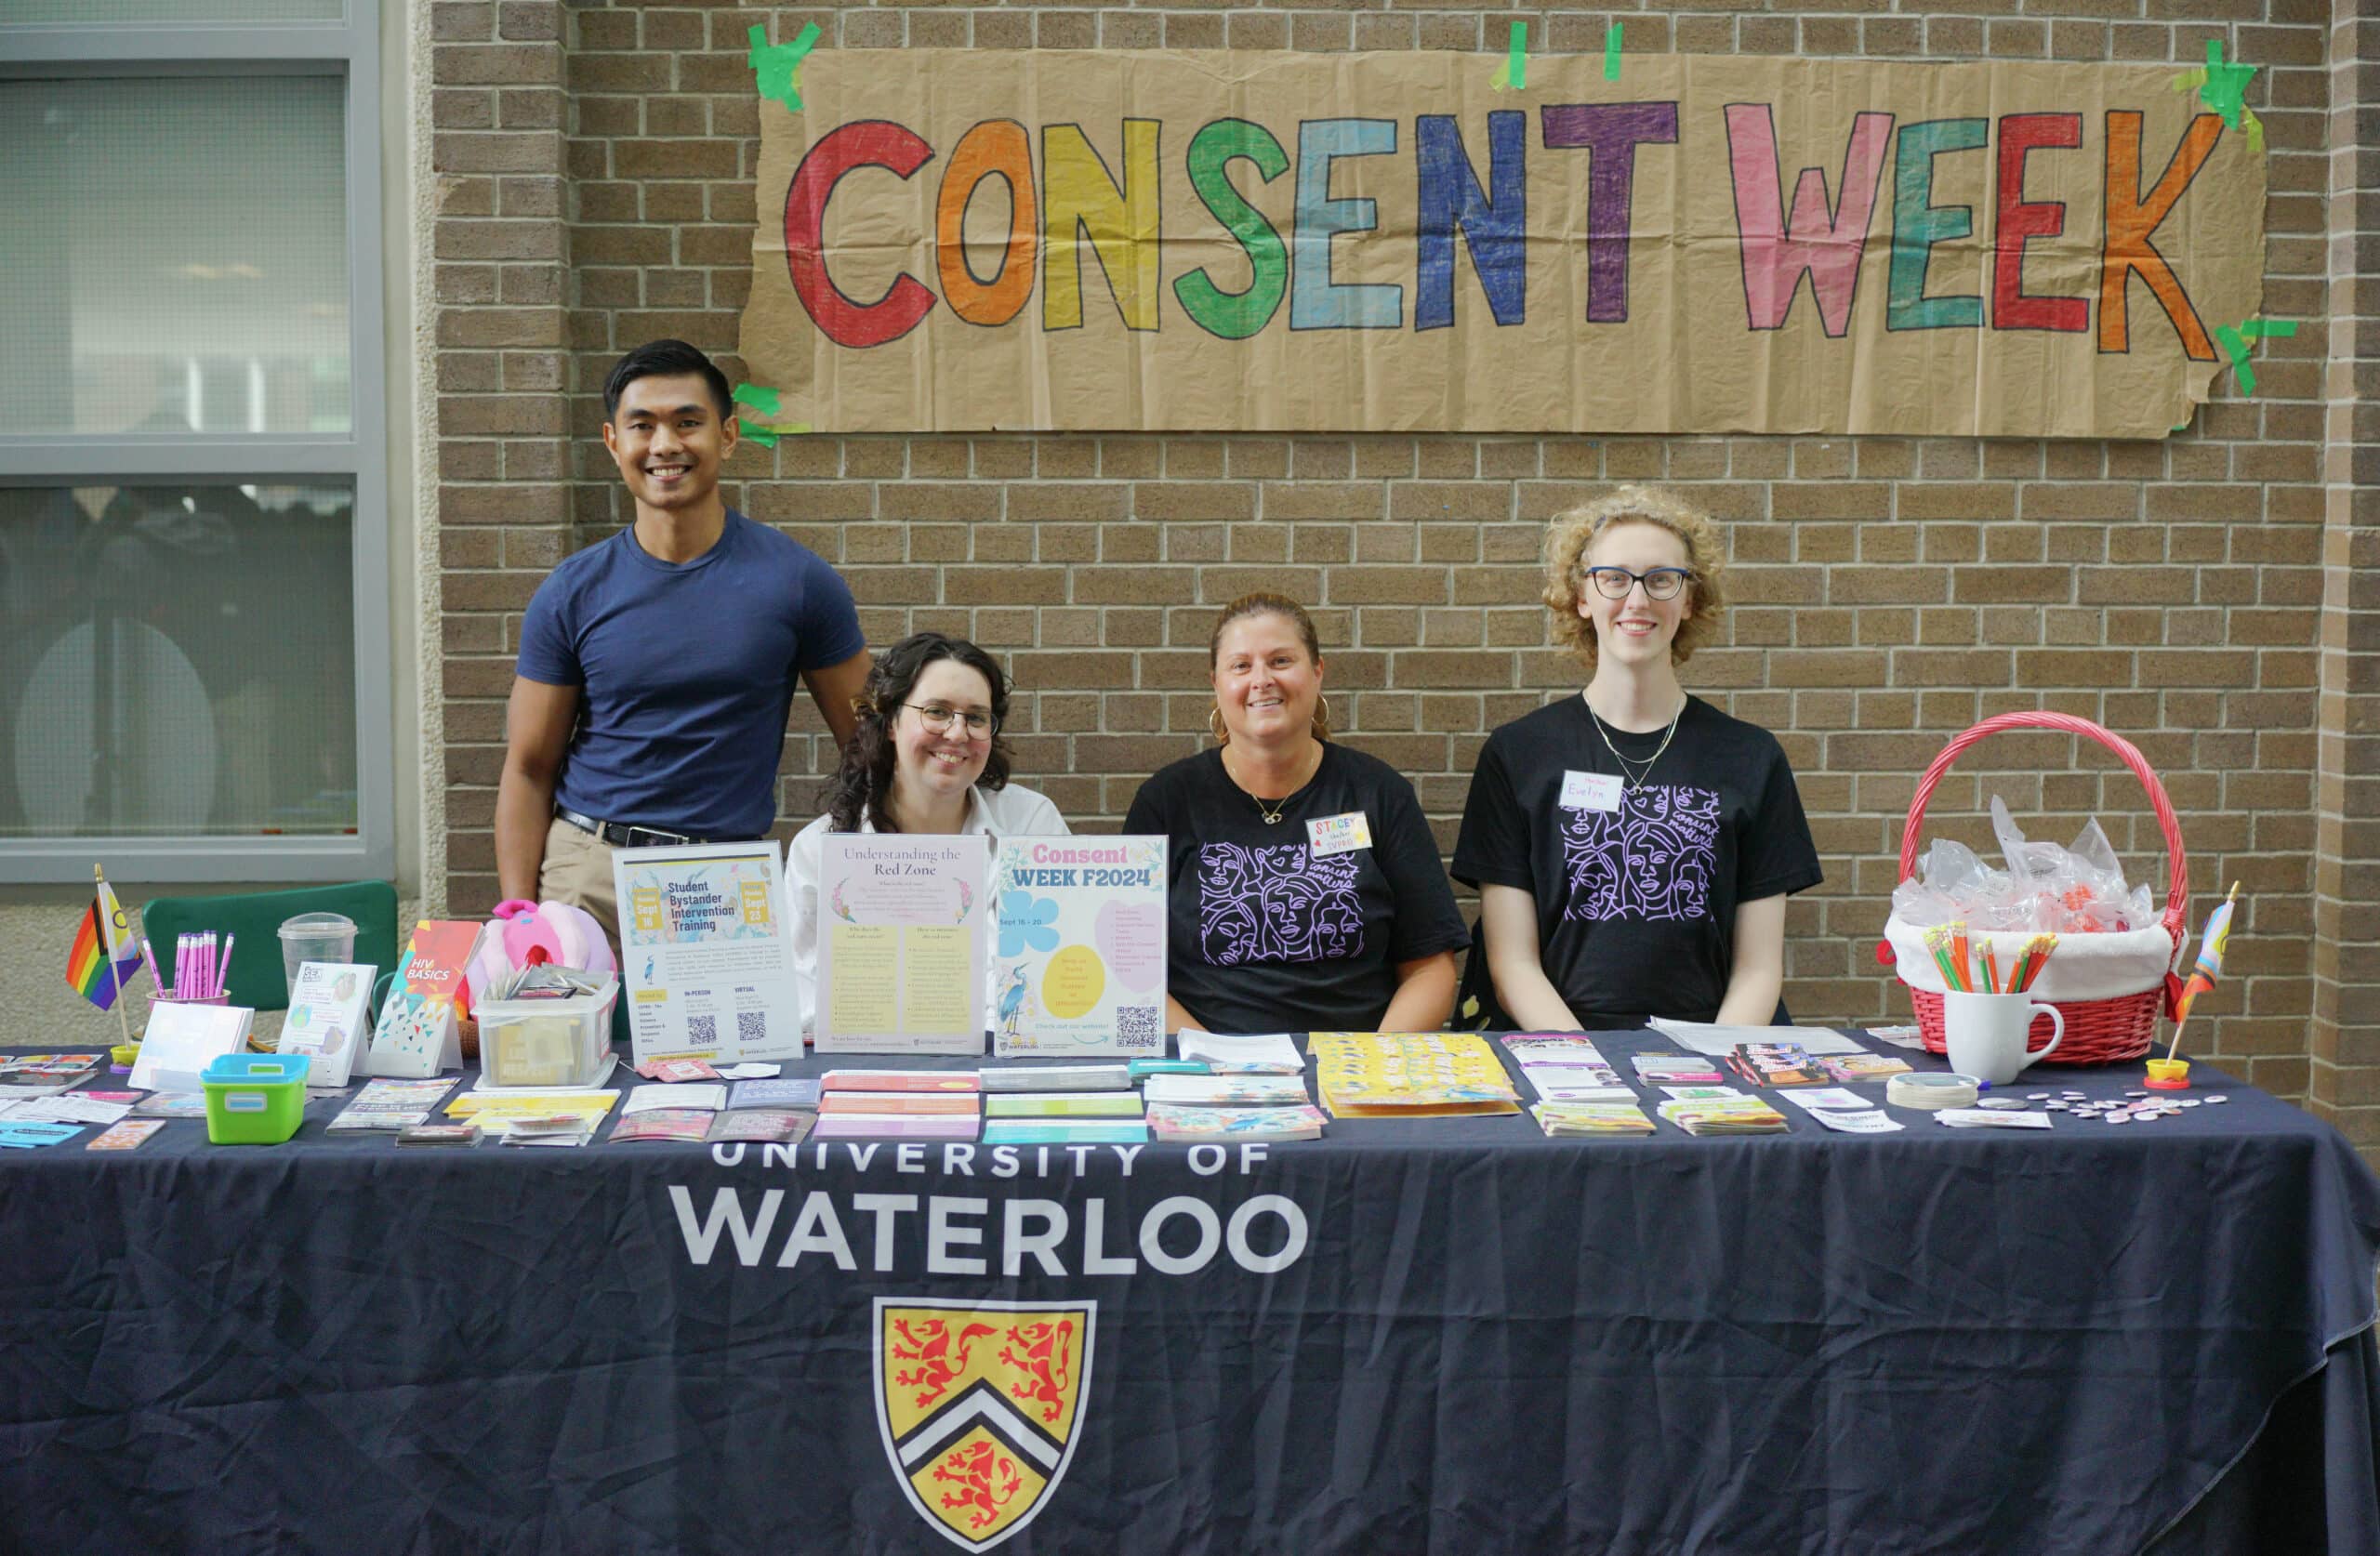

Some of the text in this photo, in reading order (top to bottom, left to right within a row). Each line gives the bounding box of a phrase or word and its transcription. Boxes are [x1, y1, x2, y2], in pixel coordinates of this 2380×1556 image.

[784, 100, 2222, 362] CONSENT WEEK
[1567, 782, 1604, 799] Evelyn
[1316, 817, 1355, 835] STACEY
[1672, 810, 1720, 840] consent
[1668, 819, 1714, 849] matters
[844, 848, 960, 863] Understanding the
[1033, 843, 1129, 864] Consent
[875, 864, 937, 876] Red Zone
[1012, 868, 1152, 887] WEEK F2024
[1309, 863, 1360, 880] consent
[668, 881, 708, 893] Student
[1305, 869, 1355, 890] matters
[669, 894, 722, 907] Bystander
[745, 898, 766, 909] Sept
[638, 904, 657, 916] Sept
[671, 906, 735, 919] Intervention
[672, 920, 716, 932] Training
[411, 958, 434, 969] HIV
[407, 969, 451, 982] BASICS
[711, 1142, 1269, 1177] UNIVERSITY OF
[668, 1185, 1309, 1277] WATERLOO
